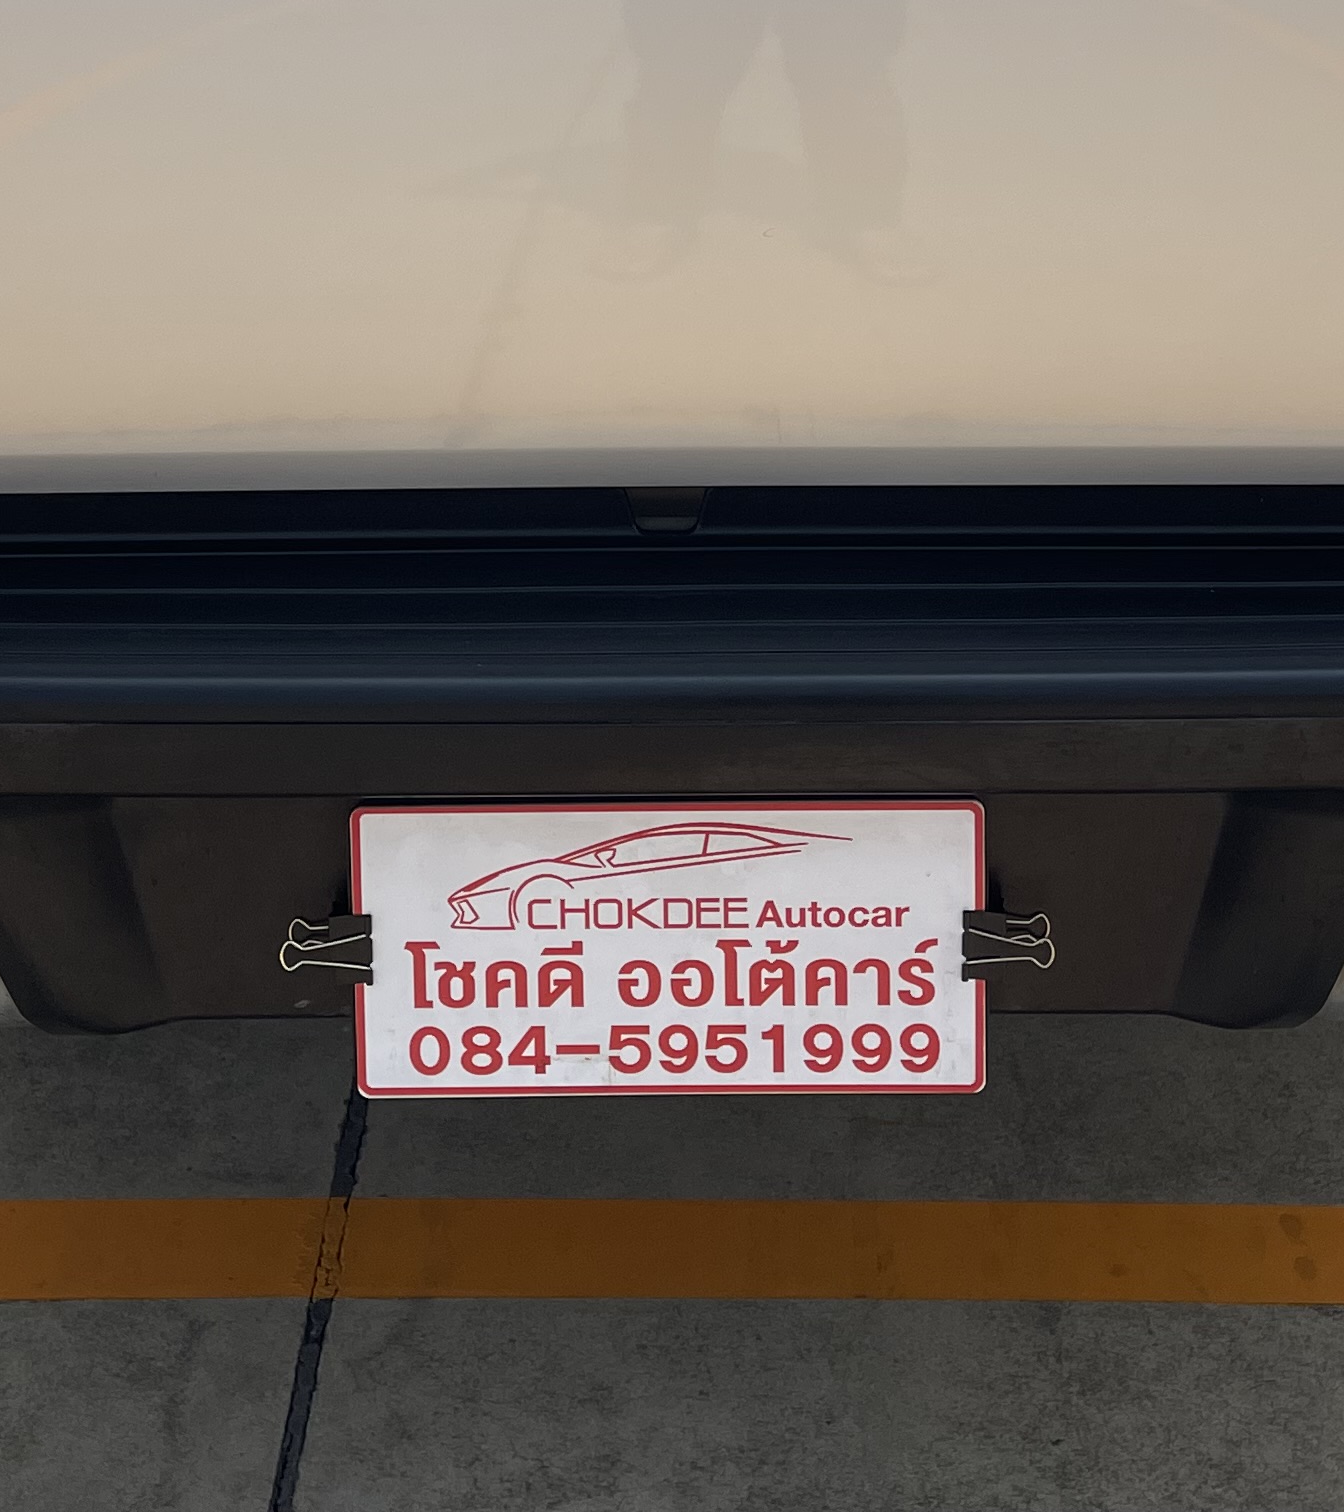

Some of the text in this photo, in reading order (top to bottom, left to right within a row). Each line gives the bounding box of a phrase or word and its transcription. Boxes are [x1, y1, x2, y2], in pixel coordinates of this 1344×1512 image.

[527, 897, 911, 930] CHOKDEE Autocar
[404, 937, 940, 1009] โชคดี ออโต้คาร์
[409, 1023, 942, 1076] 084-5951999
